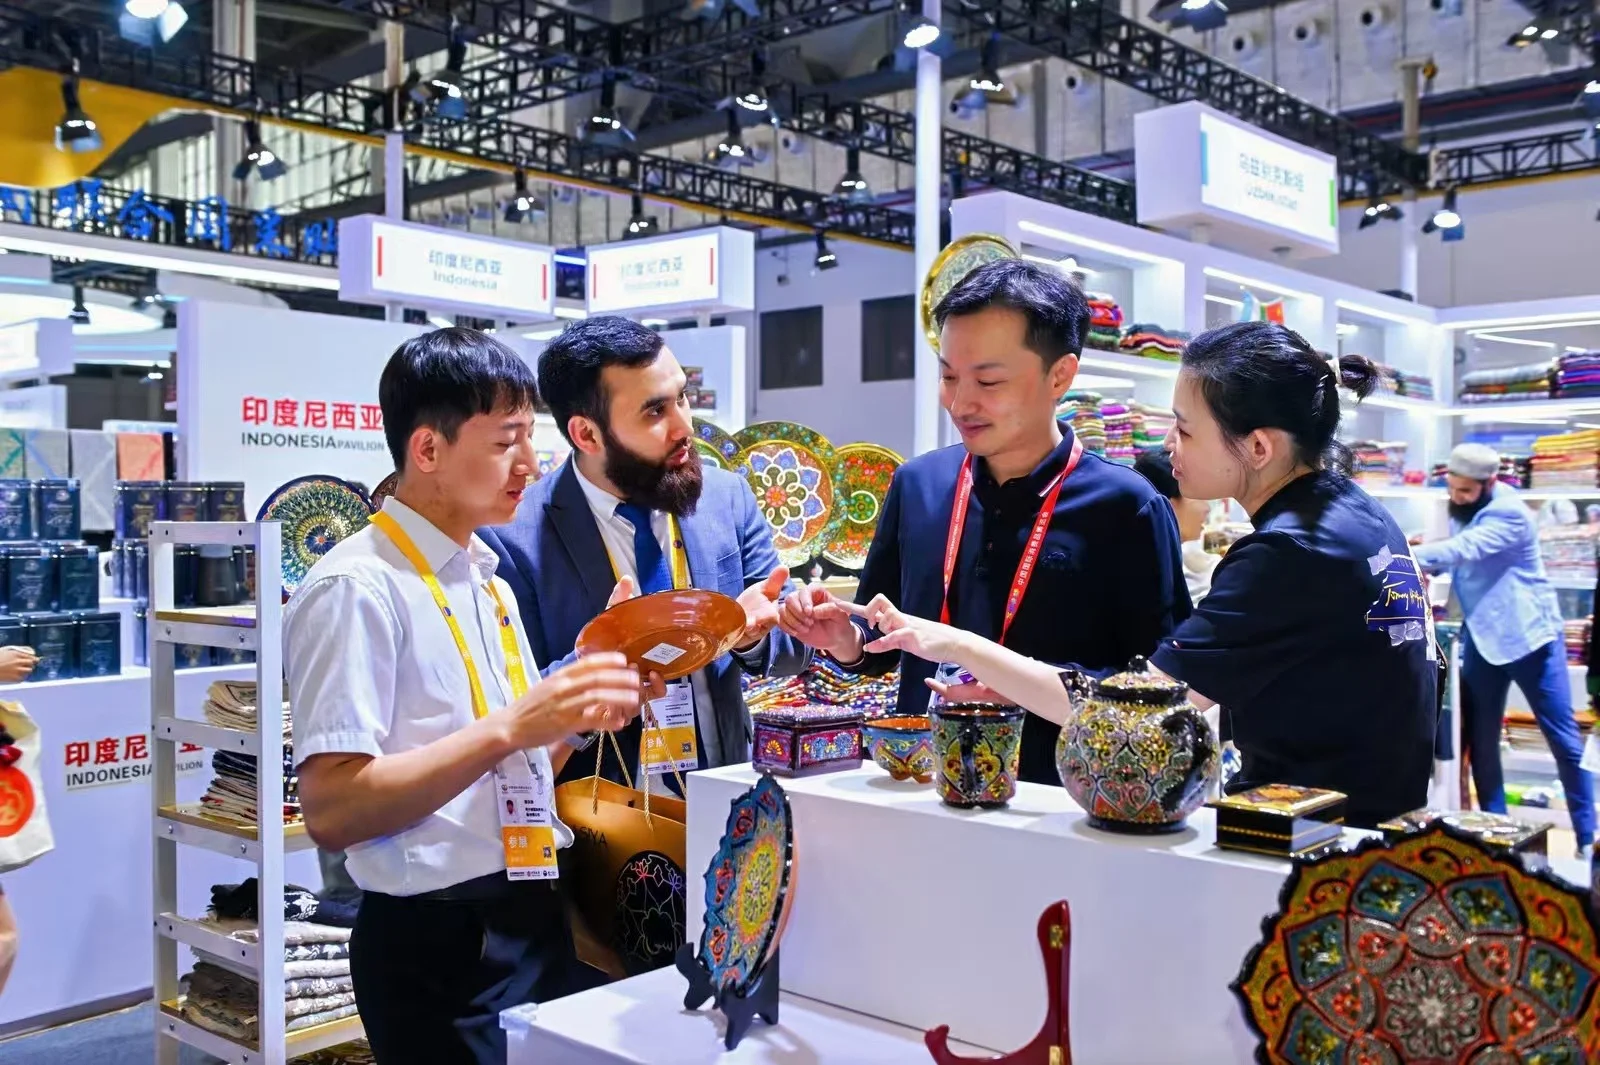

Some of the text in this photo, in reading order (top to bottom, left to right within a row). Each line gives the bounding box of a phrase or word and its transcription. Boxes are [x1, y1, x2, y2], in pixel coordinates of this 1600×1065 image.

[429, 250, 502, 275] 印度尼西亚
[433, 271, 498, 290] Indonesia
[242, 396, 384, 430] 印度尼西亚
[241, 432, 385, 451] INDONESIA PAVILION
